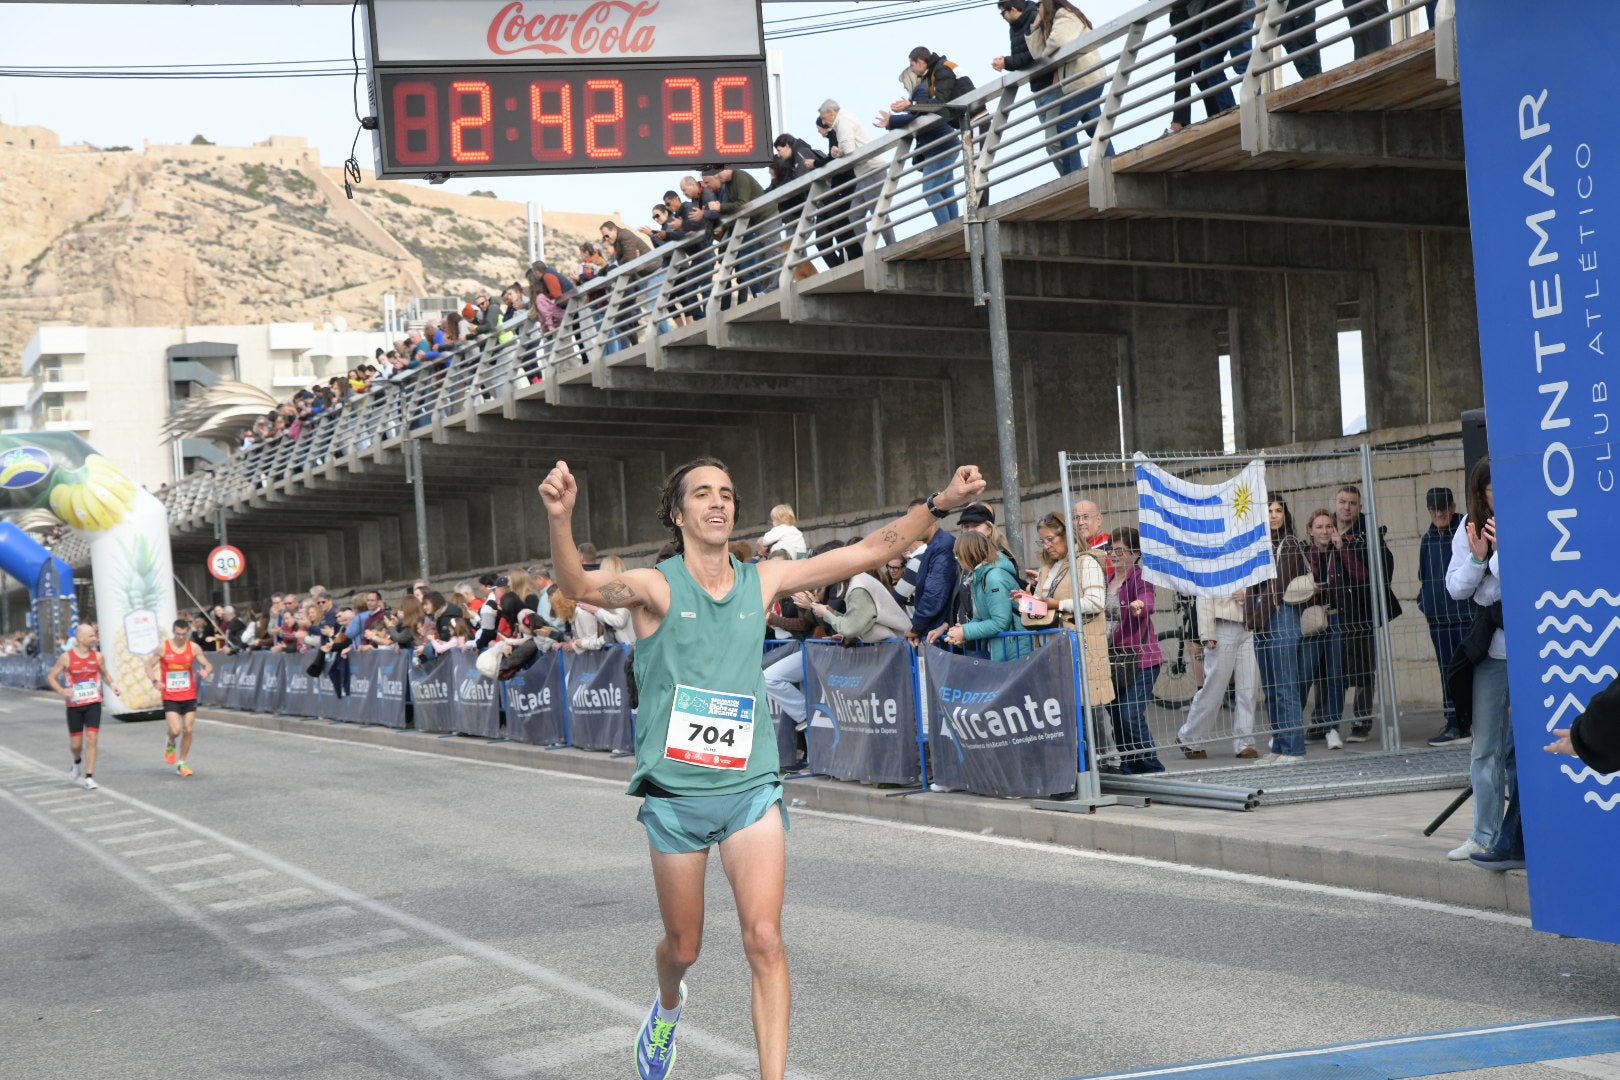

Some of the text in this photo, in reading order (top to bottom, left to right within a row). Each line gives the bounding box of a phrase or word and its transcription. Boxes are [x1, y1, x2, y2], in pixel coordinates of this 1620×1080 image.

[487, 0, 660, 54] Coca-Cola
[1518, 88, 1581, 562] MONTEMAR
[1576, 142, 1614, 492] CLUB ATLÉTICO
[216, 557, 236, 569] 30
[411, 679, 448, 699] cante
[507, 686, 551, 711] licae
[939, 686, 1000, 704] EPORTES
[832, 689, 897, 724] Alicante
[688, 722, 735, 747] 704
